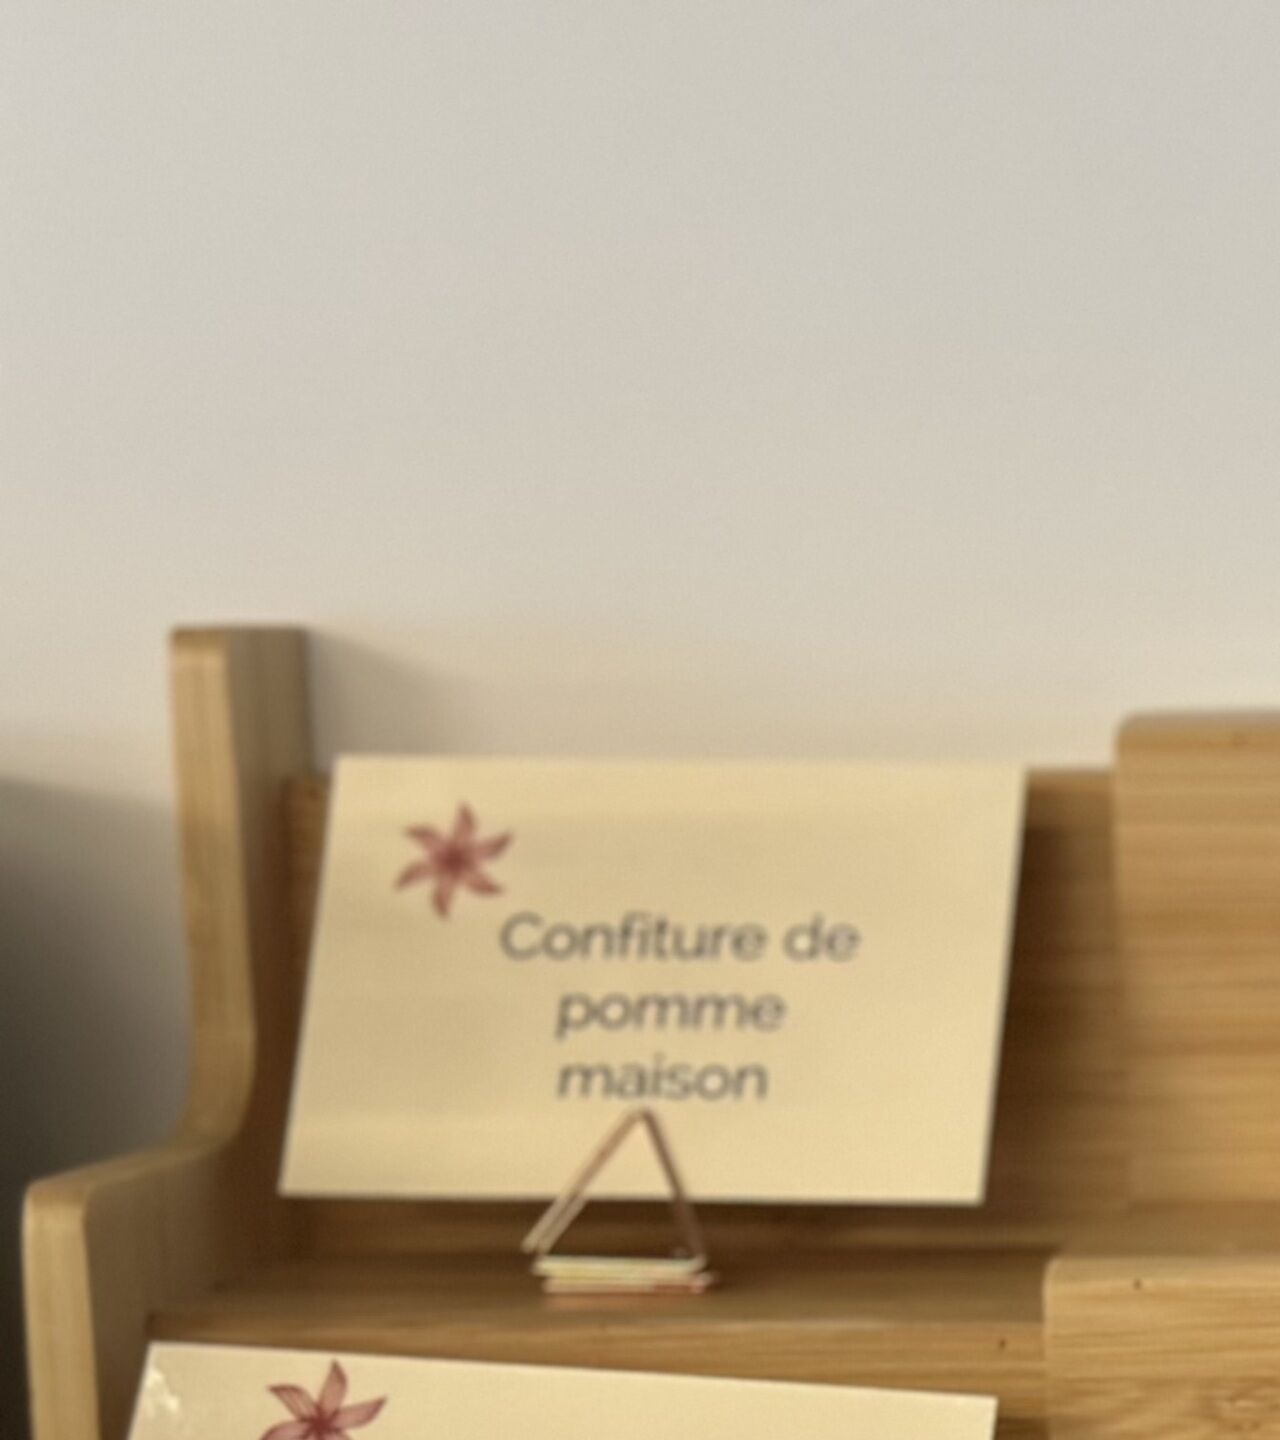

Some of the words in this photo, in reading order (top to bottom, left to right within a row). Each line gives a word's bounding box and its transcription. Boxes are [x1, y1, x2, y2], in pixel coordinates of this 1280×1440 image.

[499, 912, 766, 962] Confiture
[782, 912, 861, 962] de
[554, 993, 787, 1041] pomme
[555, 1053, 768, 1101] maison
